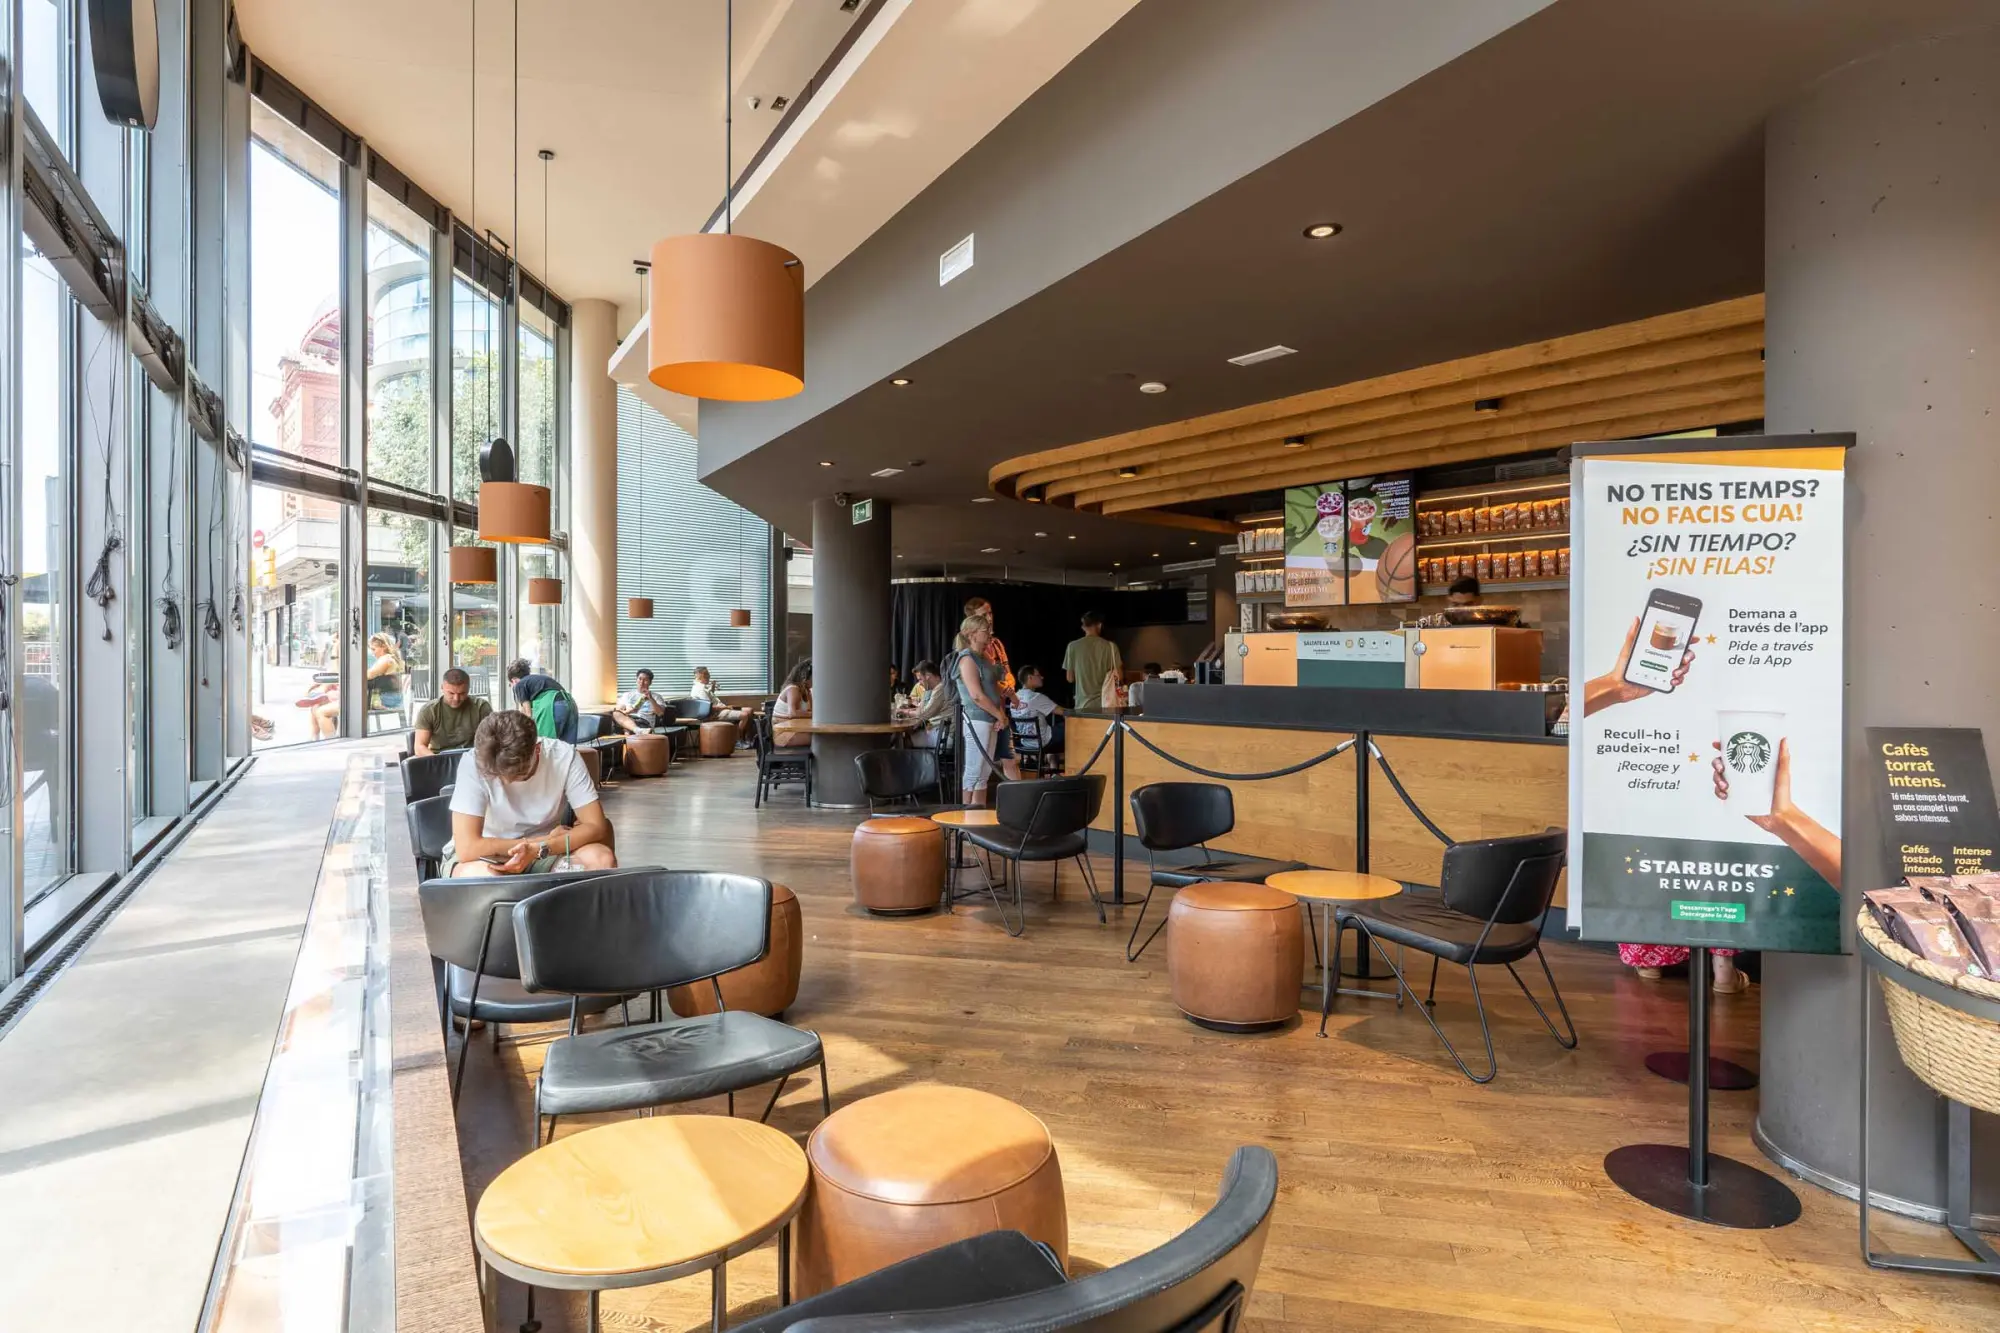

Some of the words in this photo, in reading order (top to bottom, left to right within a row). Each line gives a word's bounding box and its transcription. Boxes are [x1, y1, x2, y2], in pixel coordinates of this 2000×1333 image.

[1607, 484, 1644, 502] NO
[1651, 483, 1713, 501] TENS
[1719, 479, 1820, 499] TEMPS?
[1622, 507, 1659, 525] NO
[1667, 505, 1735, 524] FACIS
[1742, 503, 1803, 522] CUA!
[1627, 534, 1680, 557] ¿SIN
[1688, 532, 1796, 552] TIEMPO?
[1647, 557, 1696, 579] ¡SIN
[1703, 556, 1775, 575] FILAS!
[1729, 608, 1787, 619] Demana
[1789, 611, 1797, 619] a
[1729, 622, 1770, 633] través
[1773, 622, 1791, 633] de
[1728, 640, 1758, 652] Pide
[1761, 643, 1769, 652] a
[1772, 640, 1814, 652] través
[1728, 654, 1746, 665] de
[1749, 654, 1760, 665] la
[1763, 655, 1792, 667] App
[1604, 729, 1671, 740] Recull-ho
[1676, 729, 1680, 740] i
[1596, 743, 1680, 755] gaudeix-ne!
[1882, 743, 1929, 756] Cafès
[1617, 761, 1669, 775] ¡Recoge
[1671, 764, 1680, 774] y
[1885, 759, 1935, 772] torrat
[1628, 778, 1680, 791] disfruta!
[1888, 773, 1946, 788] intens.
[1915, 793, 1937, 802] temps
[1916, 804, 1944, 812] complet
[1895, 813, 1918, 822] sabors
[1918, 814, 1951, 823] intensos.
[1901, 845, 1930, 854] Cafés
[1953, 846, 1992, 856] Intense
[1902, 855, 1943, 864] tostado
[1955, 857, 1982, 865] roast
[1904, 864, 1945, 874] intenso.
[1659, 878, 1755, 893] REWARDS
